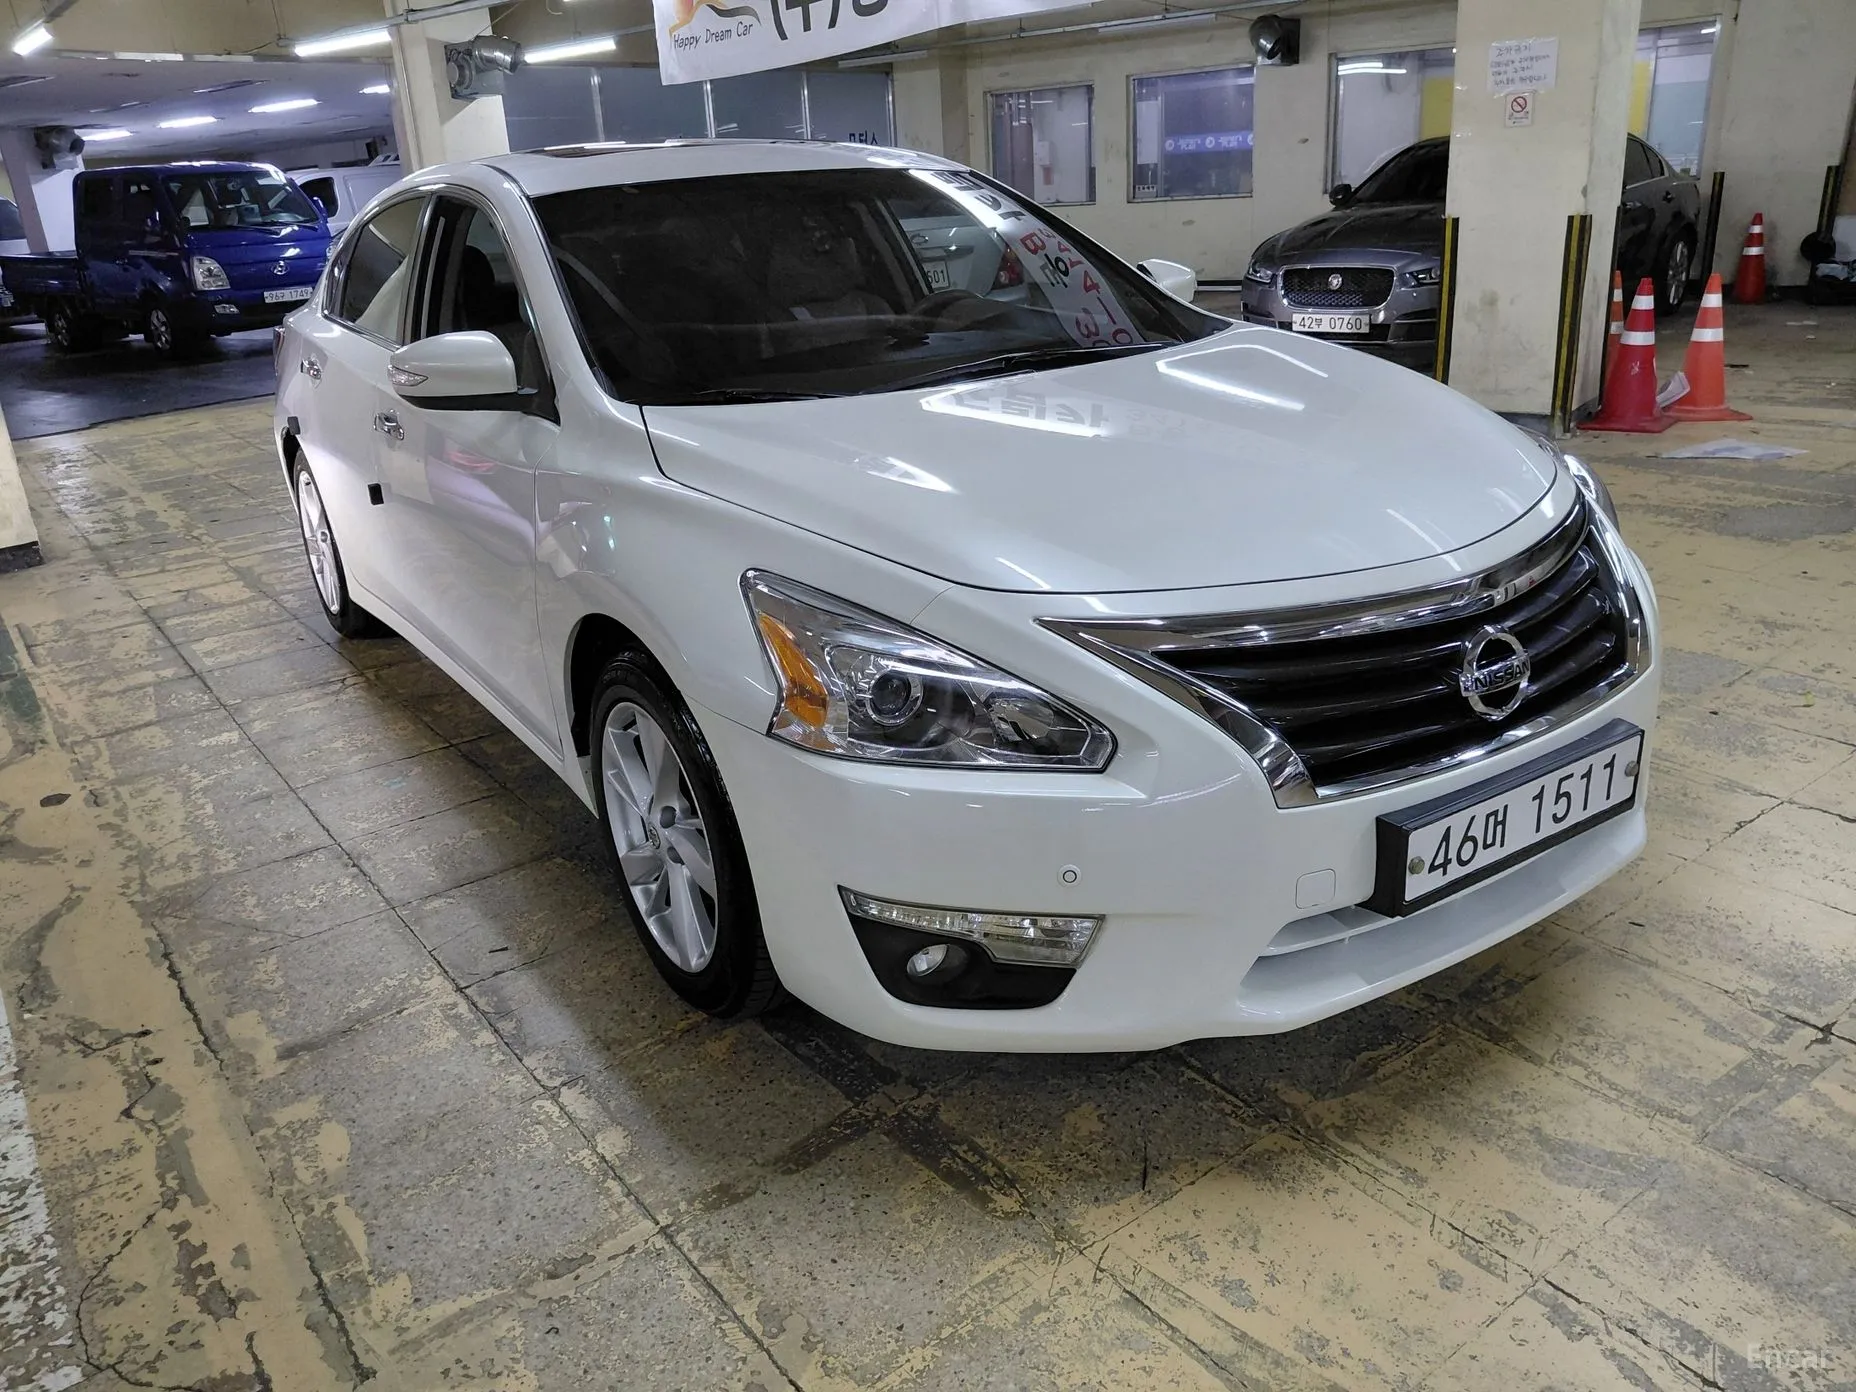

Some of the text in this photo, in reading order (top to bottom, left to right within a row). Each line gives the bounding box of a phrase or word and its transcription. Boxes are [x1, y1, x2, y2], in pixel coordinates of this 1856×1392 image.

[673, 21, 754, 51] Happy Dream Car
[289, 289, 309, 299] 1749
[1298, 316, 1362, 331] 42부 0760
[1474, 661, 1530, 692] NISSAN
[1427, 753, 1617, 877] 46머 1511
